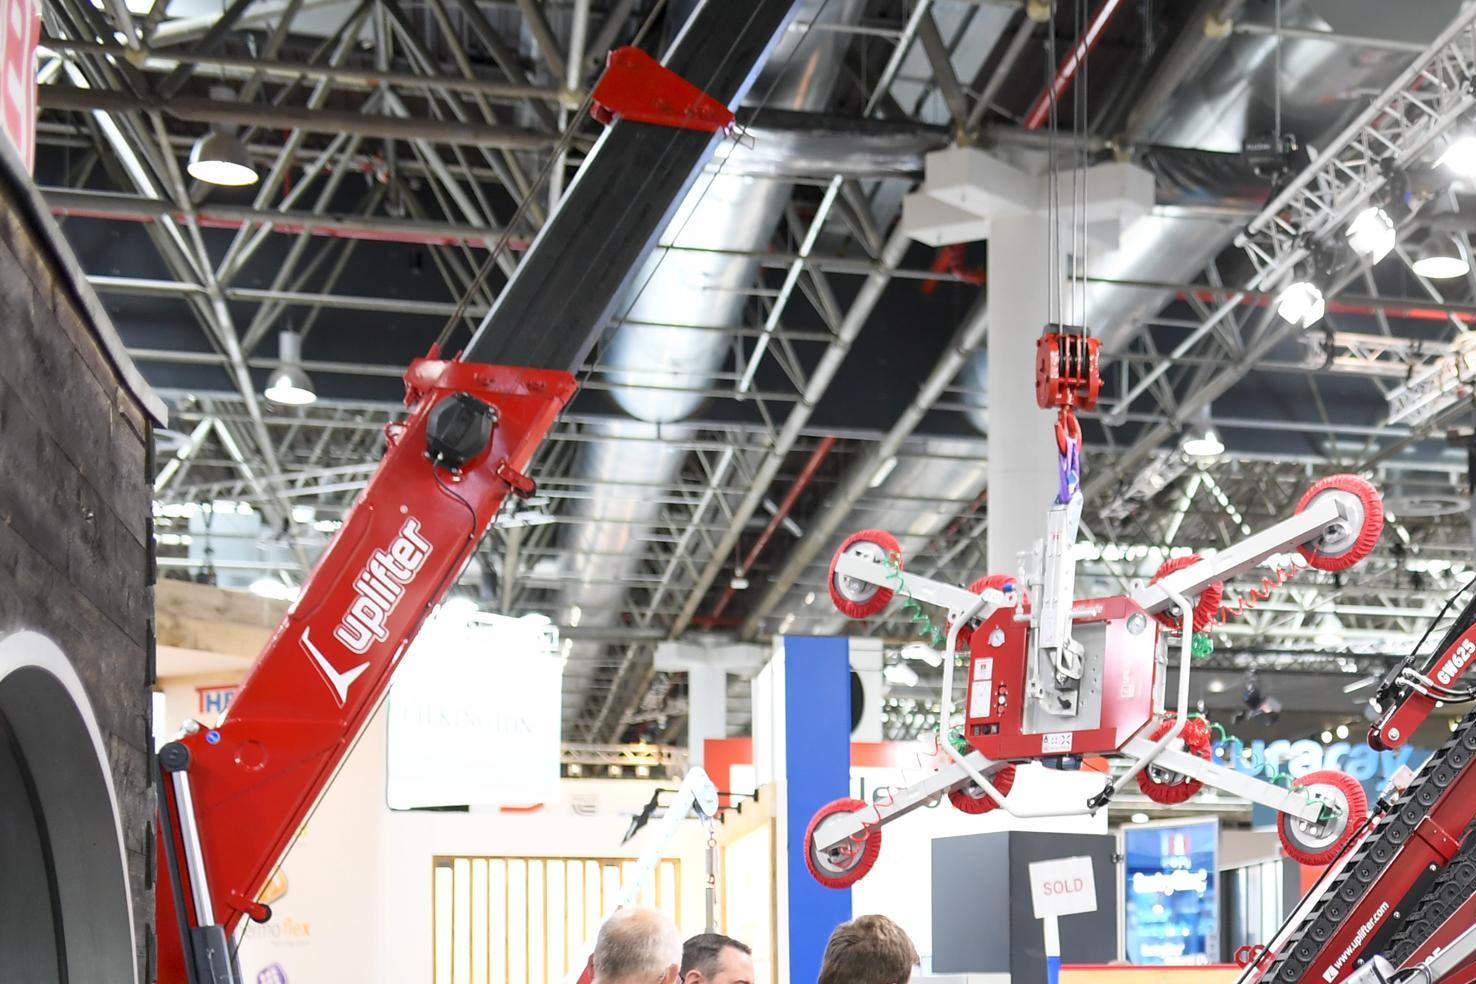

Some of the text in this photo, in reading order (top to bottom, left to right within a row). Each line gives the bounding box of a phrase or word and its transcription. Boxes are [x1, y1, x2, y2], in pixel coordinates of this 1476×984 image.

[333, 516, 433, 653] uplifter
[1436, 638, 1476, 685] GW625
[1043, 878, 1083, 896] SOLD
[1334, 901, 1390, 970] www.uplifter.com
